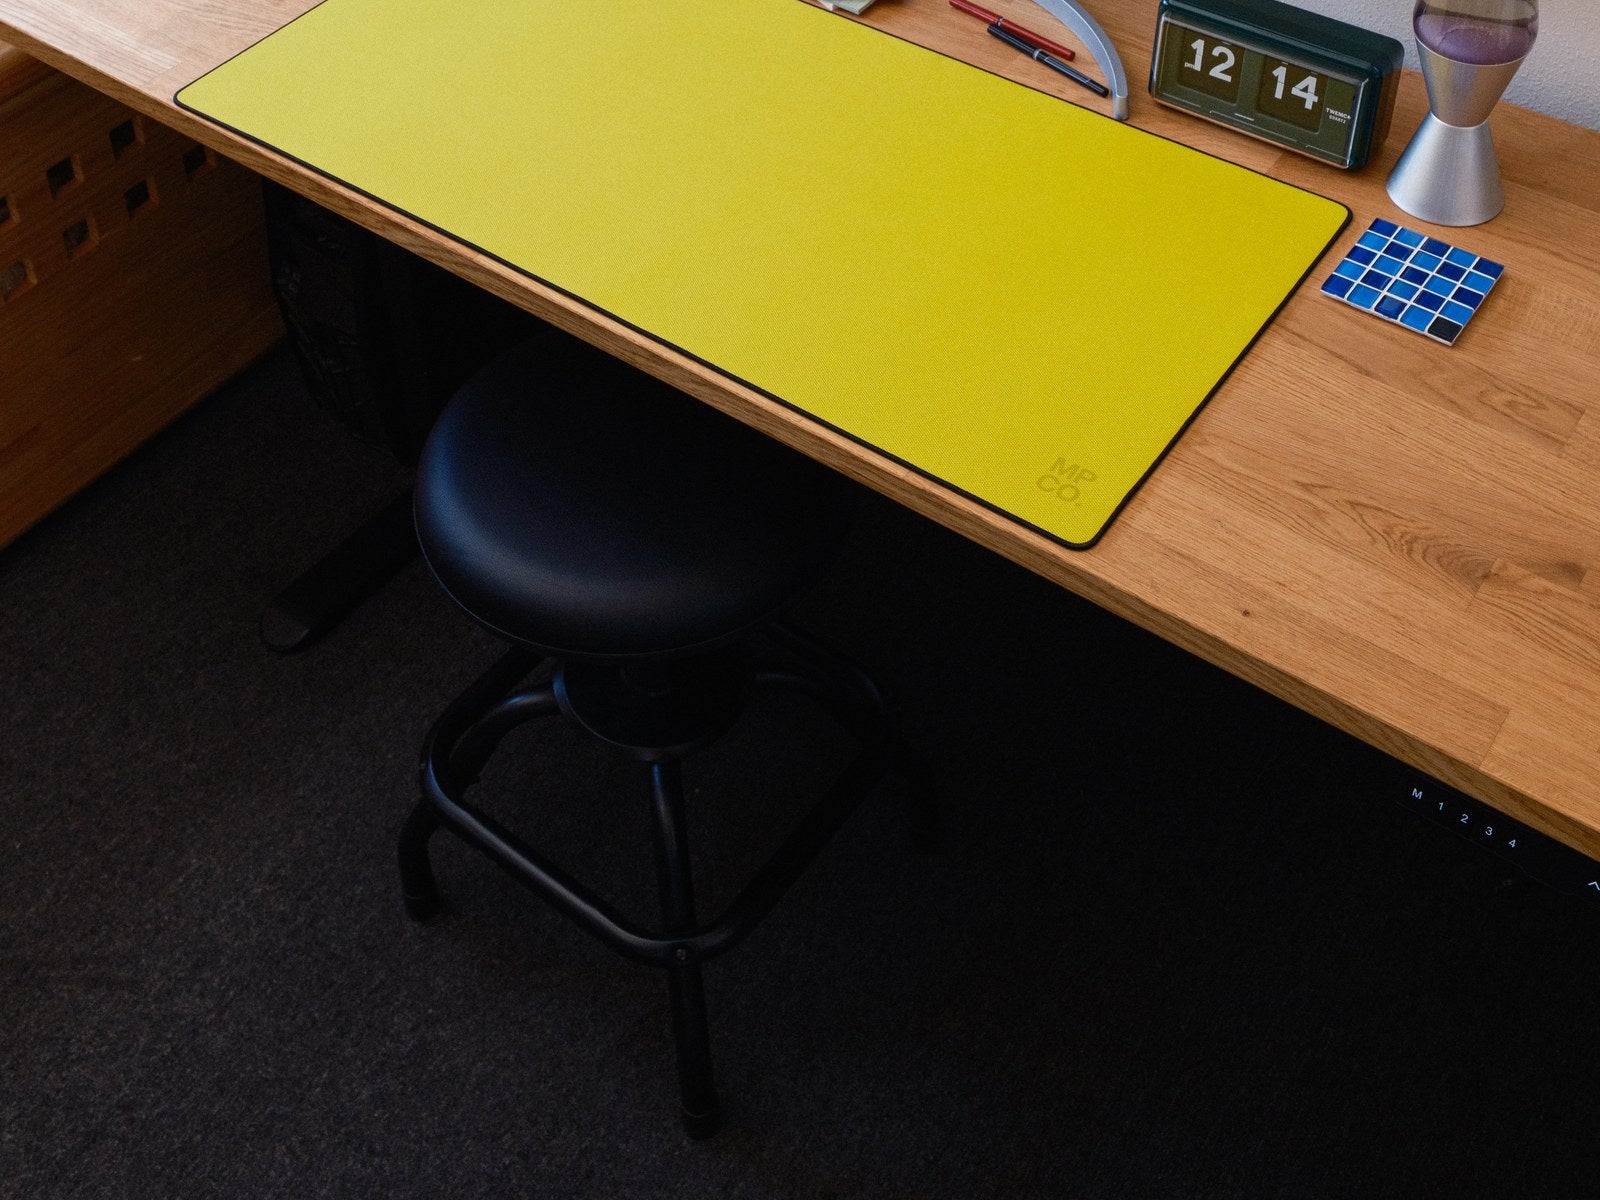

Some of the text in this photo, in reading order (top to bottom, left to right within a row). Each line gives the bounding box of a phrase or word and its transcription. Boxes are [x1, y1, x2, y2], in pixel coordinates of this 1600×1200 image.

[1191, 38, 1319, 111] 12 14
[1049, 456, 1098, 483] MP
[1412, 788, 1517, 848] M 1 2 3 4
